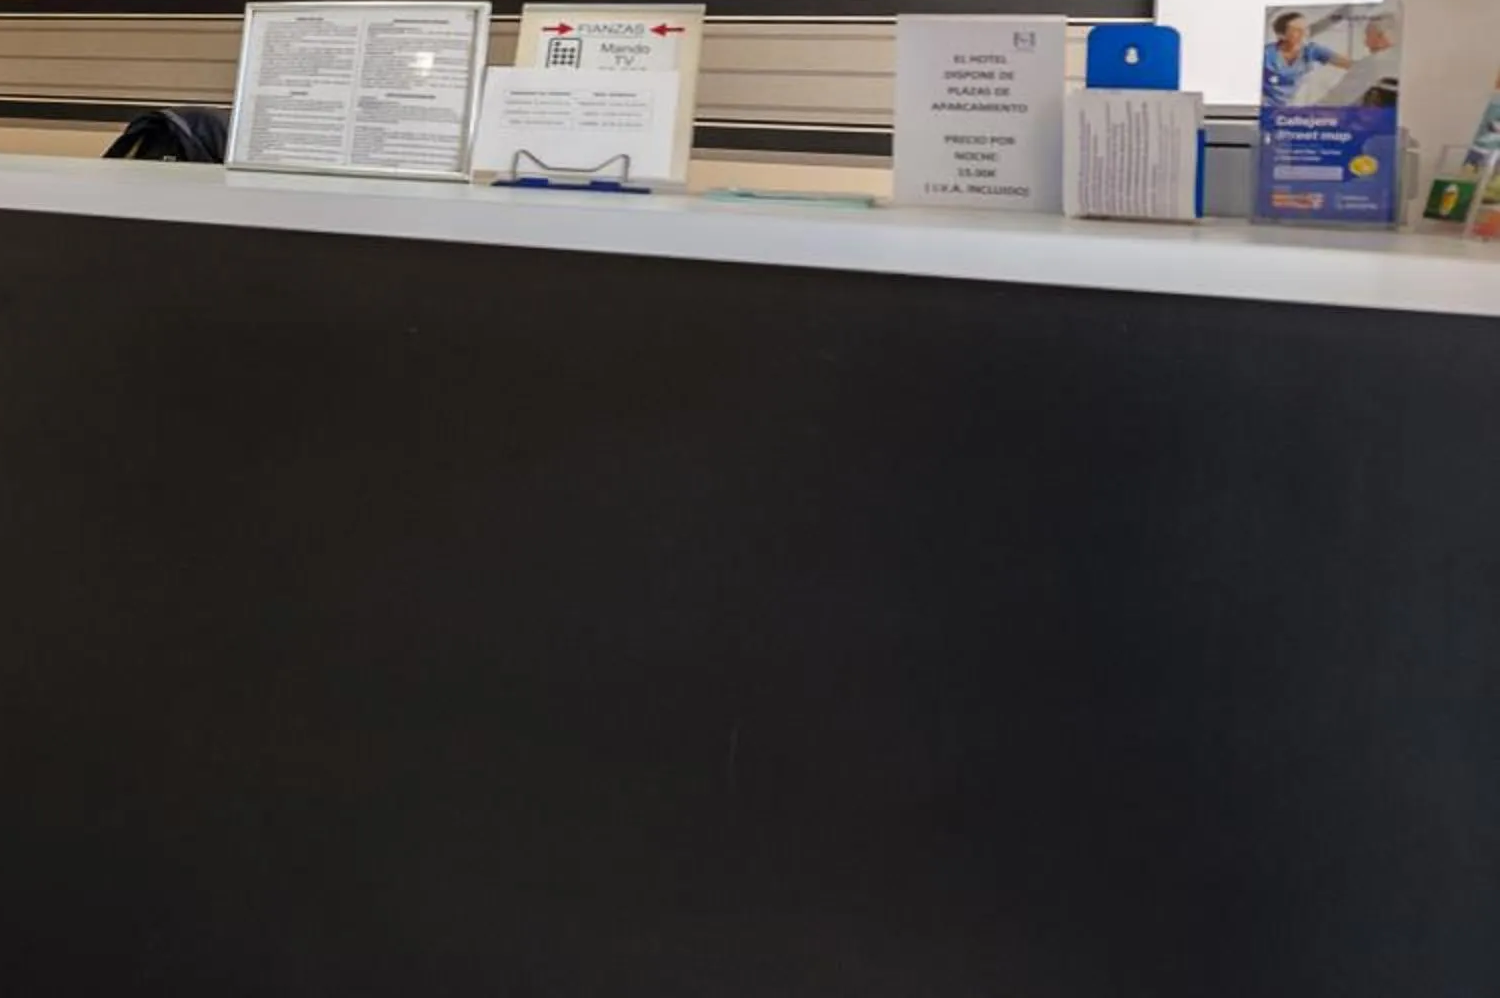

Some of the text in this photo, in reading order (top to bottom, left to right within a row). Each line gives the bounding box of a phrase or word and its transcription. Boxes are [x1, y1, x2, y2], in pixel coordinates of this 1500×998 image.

[577, 23, 645, 36] FIANZAS
[600, 42, 651, 55] Mando
[614, 56, 636, 66] TV
[953, 54, 1007, 65] EL HOTEL
[944, 70, 1014, 81] DISPONE DE
[947, 86, 1011, 97] PLAZAS DE
[930, 102, 1029, 114] APARCAMIENTO
[944, 134, 1016, 146] PRECIO POR
[1321, 132, 1353, 144] map
